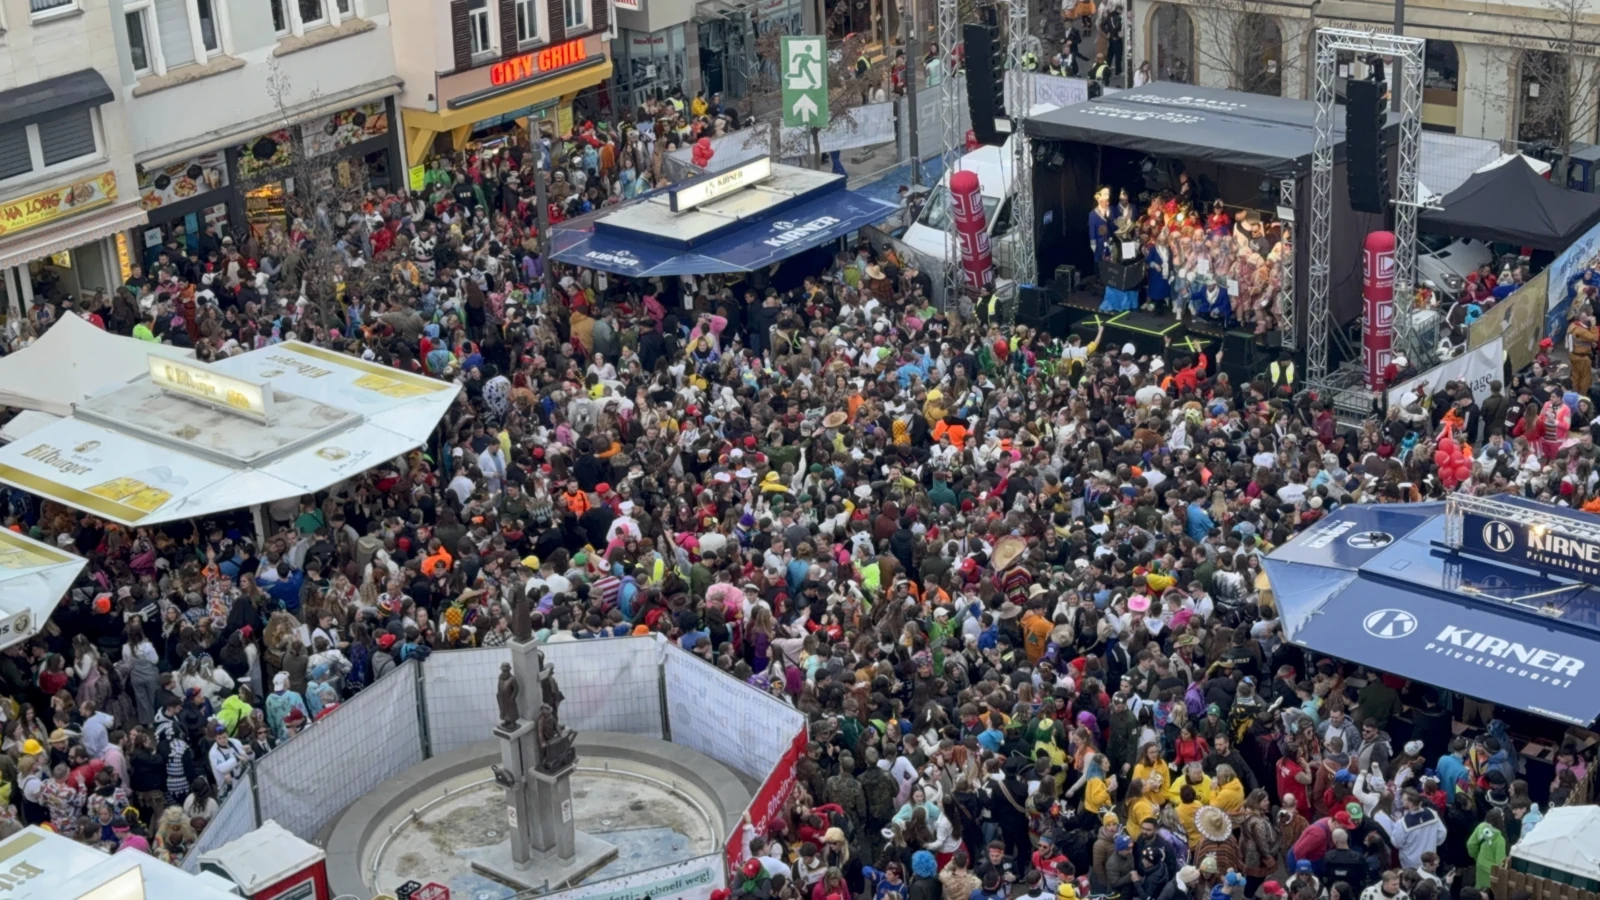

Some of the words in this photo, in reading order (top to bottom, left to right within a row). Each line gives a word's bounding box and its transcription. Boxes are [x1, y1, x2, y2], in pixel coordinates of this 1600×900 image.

[491, 53, 533, 86] CITY
[538, 38, 587, 71] GRILL
[764, 215, 841, 248] KIRNER
[585, 250, 640, 267] KIRNER
[21, 443, 94, 476] Bitburger
[1424, 642, 1572, 689] Privatbrauerei
[1435, 625, 1585, 677] KIRNER
[645, 879, 683, 898] schnell
[685, 869, 711, 884] weg!
